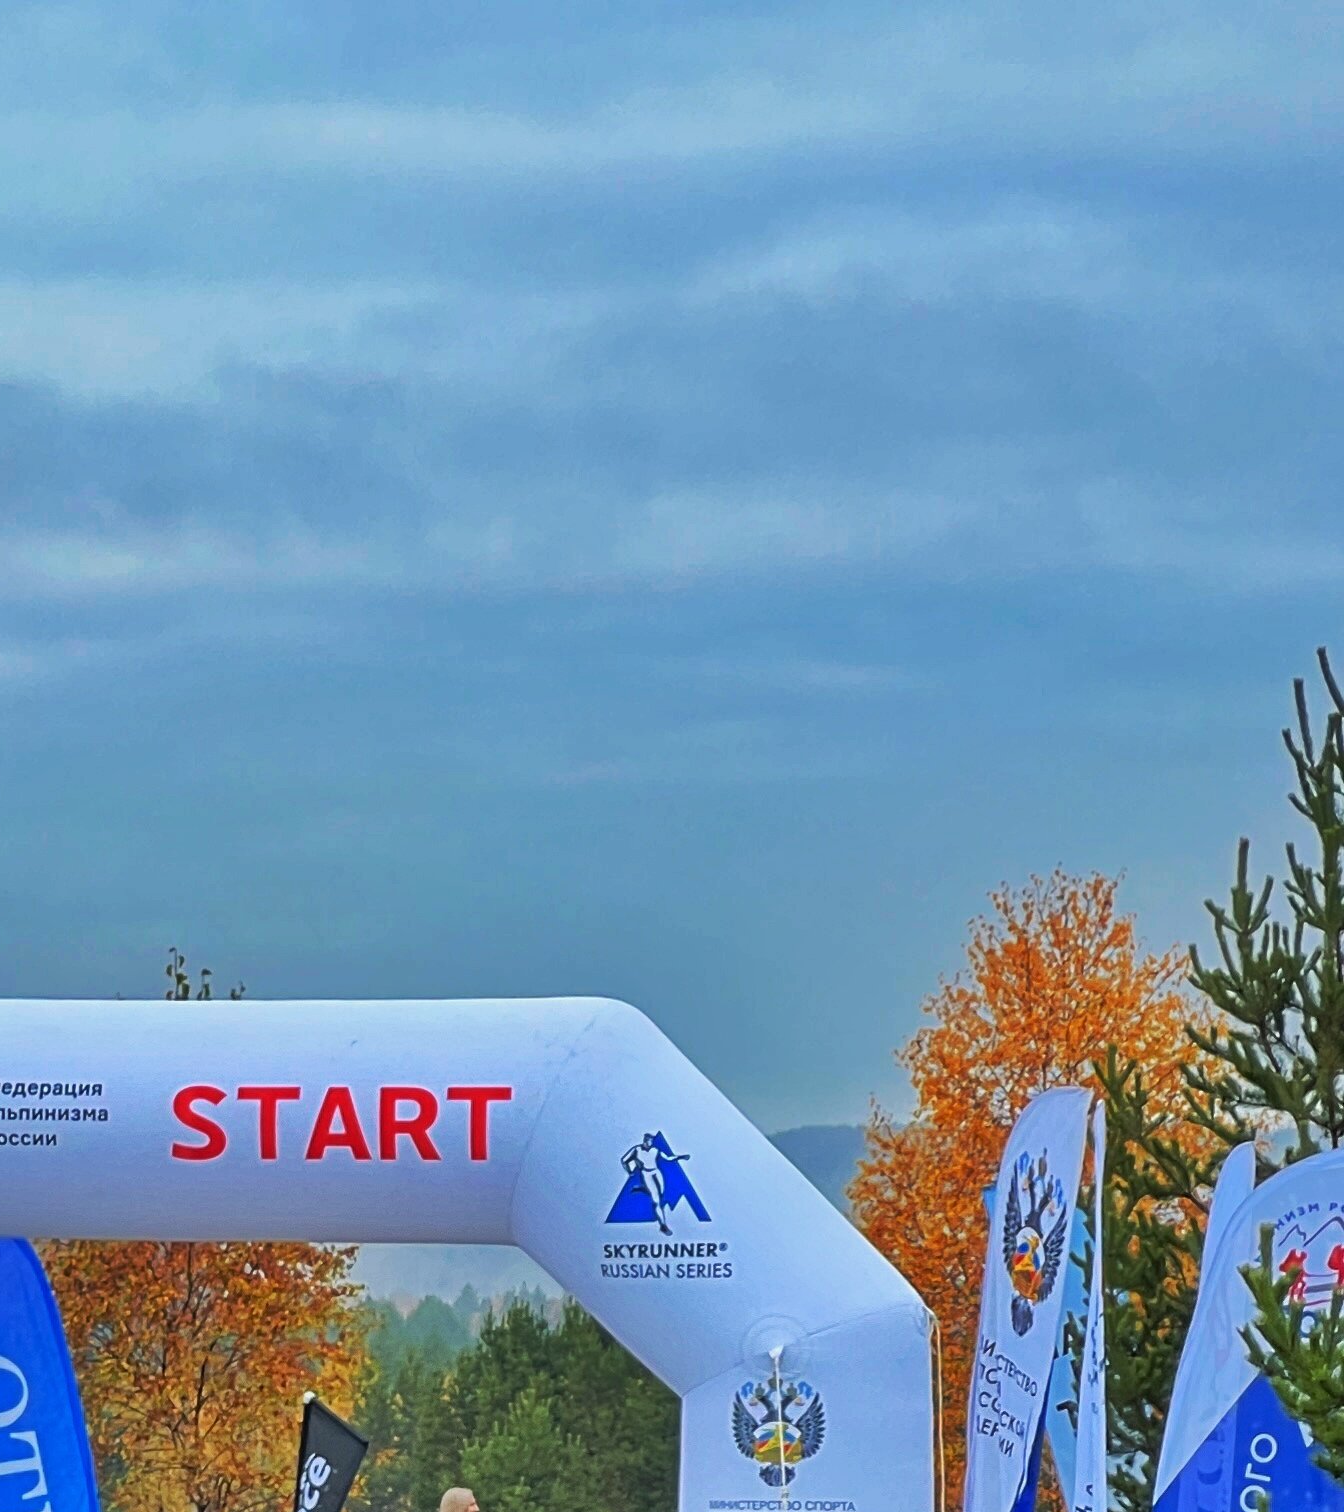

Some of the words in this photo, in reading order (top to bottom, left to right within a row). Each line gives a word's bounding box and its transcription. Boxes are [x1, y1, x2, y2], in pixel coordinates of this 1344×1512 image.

[171, 1085, 512, 1161] START
[600, 1263, 670, 1279] RUSSIAN
[676, 1262, 733, 1279] SERIES
[804, 1500, 857, 1512] СПОРТА
